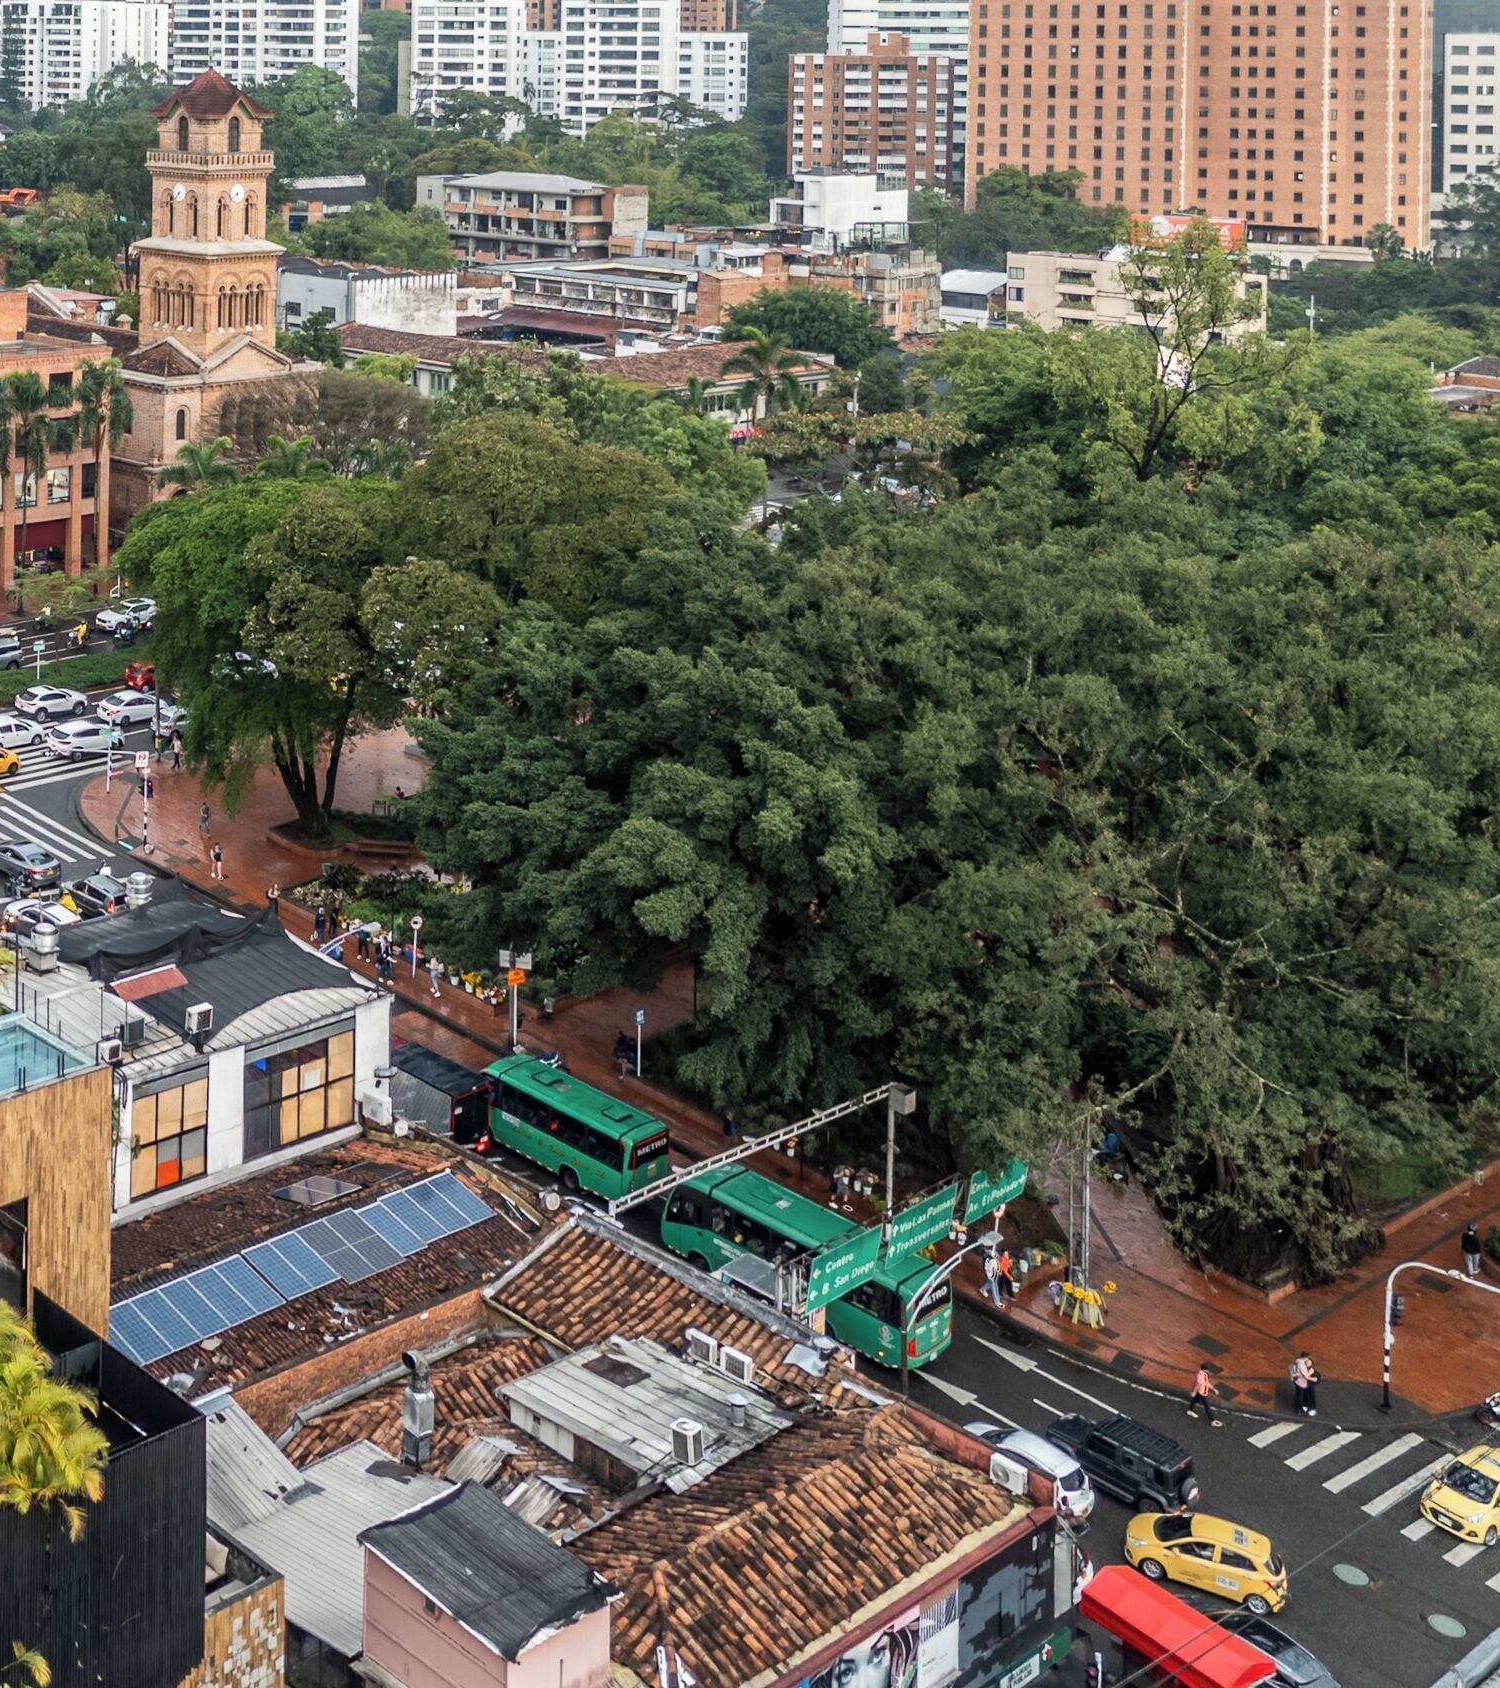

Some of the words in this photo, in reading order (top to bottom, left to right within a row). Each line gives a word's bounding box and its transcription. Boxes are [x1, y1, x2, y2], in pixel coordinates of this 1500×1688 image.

[637, 1138, 667, 1156] METRO
[897, 1218, 949, 1253] Transversales
[826, 1253, 854, 1273] Centro
[834, 1274, 849, 1287] San
[851, 1261, 874, 1278] Diego
